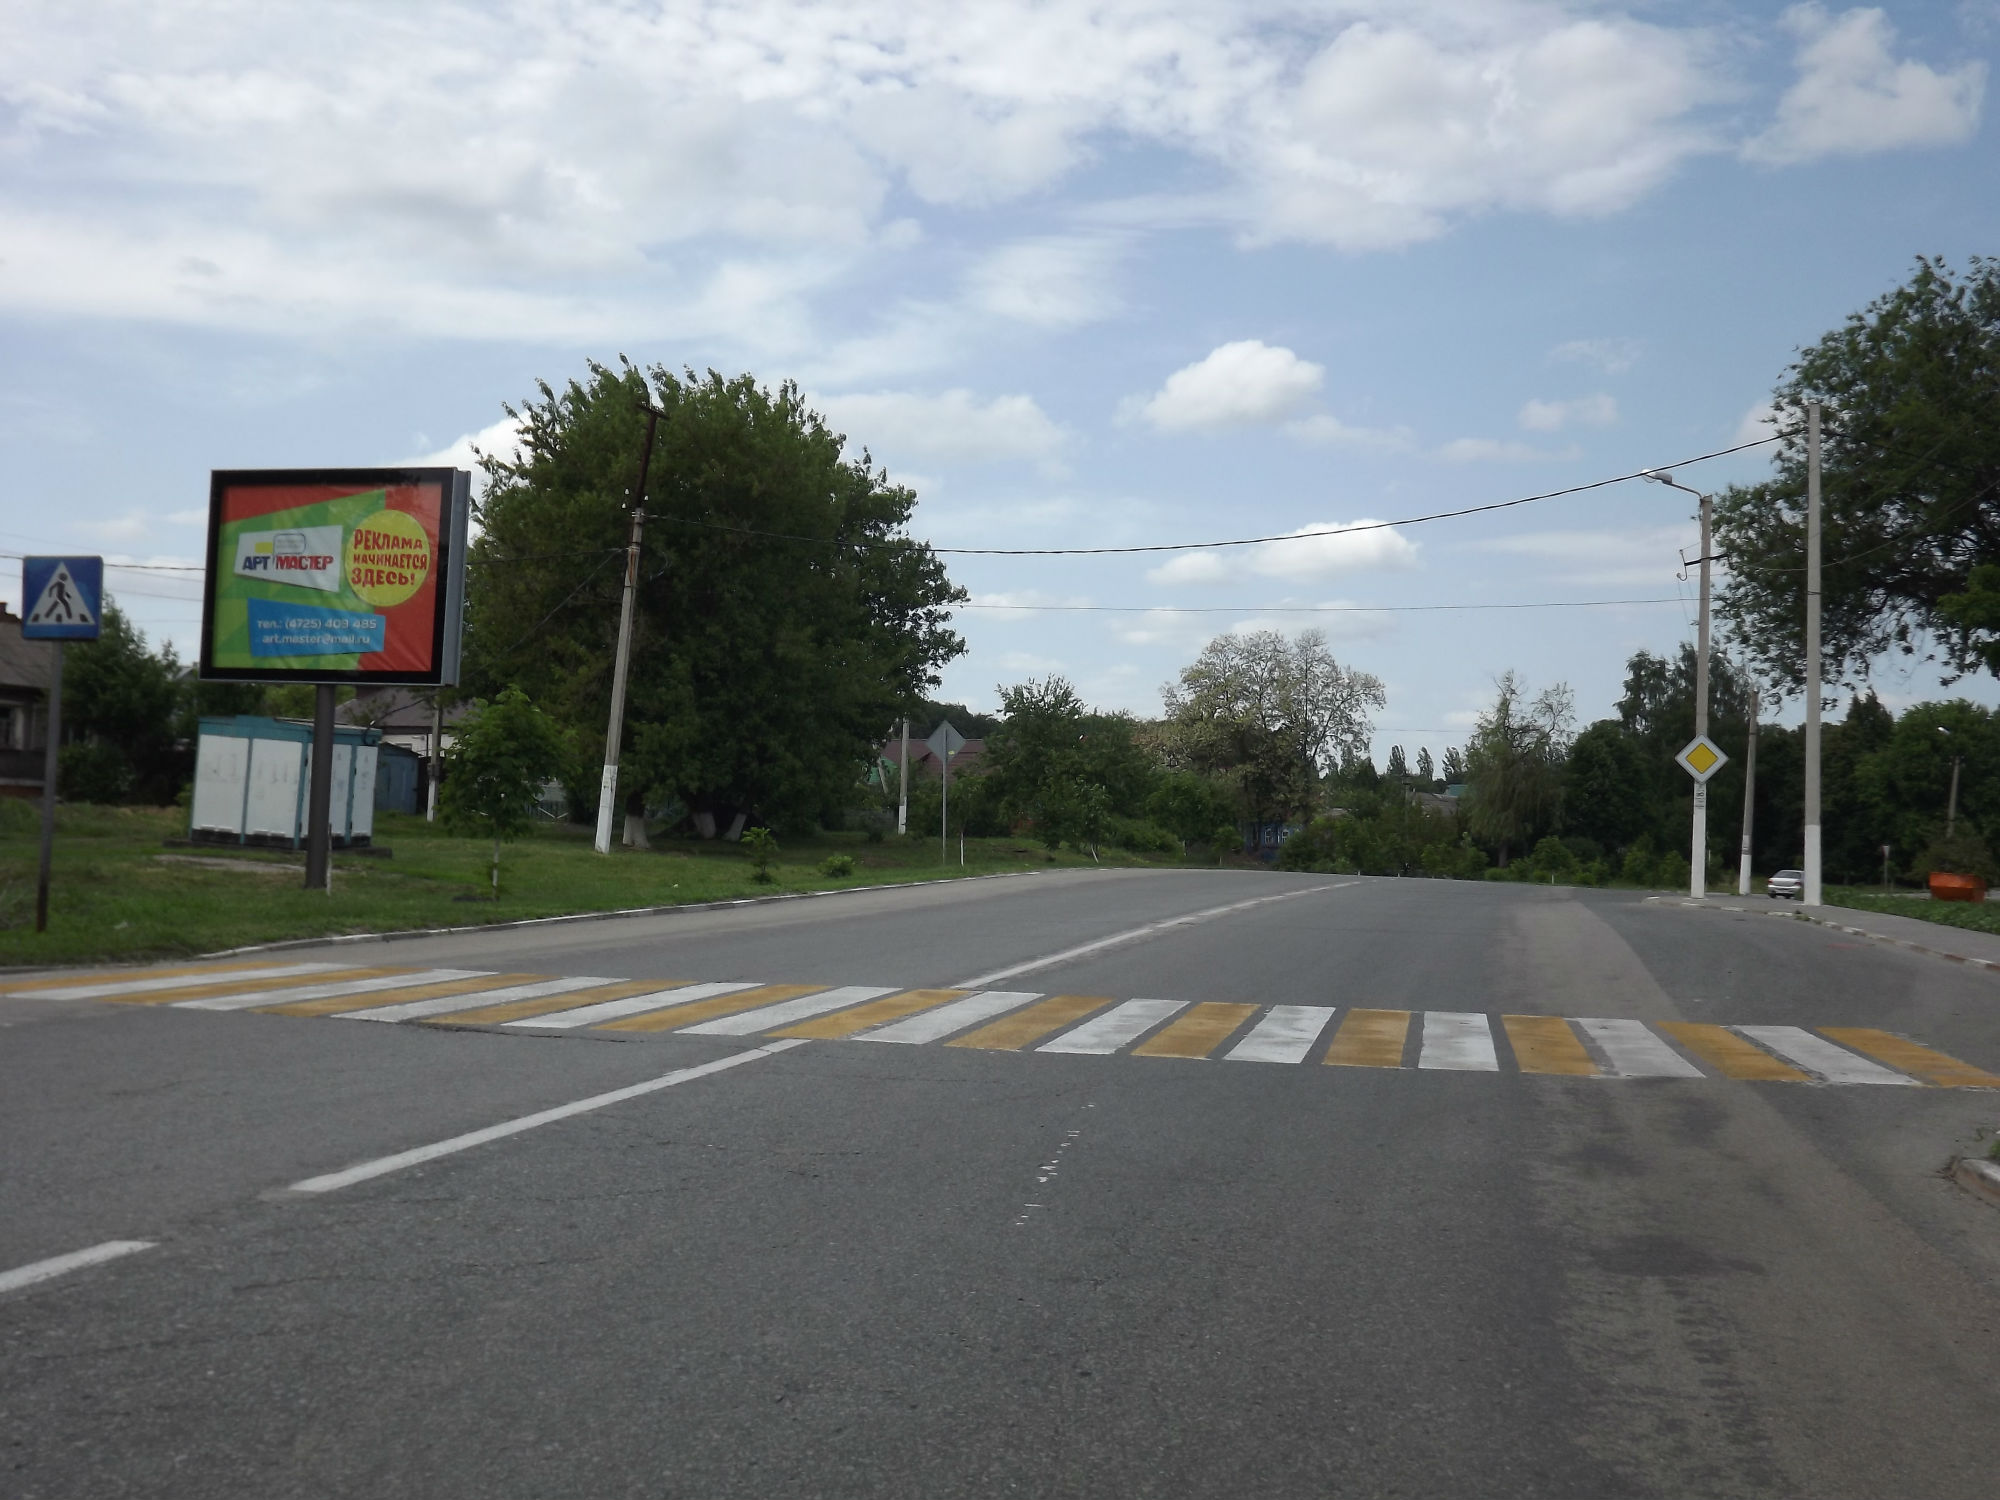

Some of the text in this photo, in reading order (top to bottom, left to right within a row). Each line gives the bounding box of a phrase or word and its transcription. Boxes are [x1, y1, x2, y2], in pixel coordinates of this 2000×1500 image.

[353, 529, 423, 550] РЕКЛАМА
[242, 556, 334, 570] АРТ МАСТЕР
[353, 554, 428, 571] НАЧИНАЕТСЯ
[351, 568, 415, 588] ЗДЕСЬ!
[285, 618, 321, 630] (4725)
[353, 619, 377, 629] 485
[262, 634, 370, 644] art.master@mail.ru
